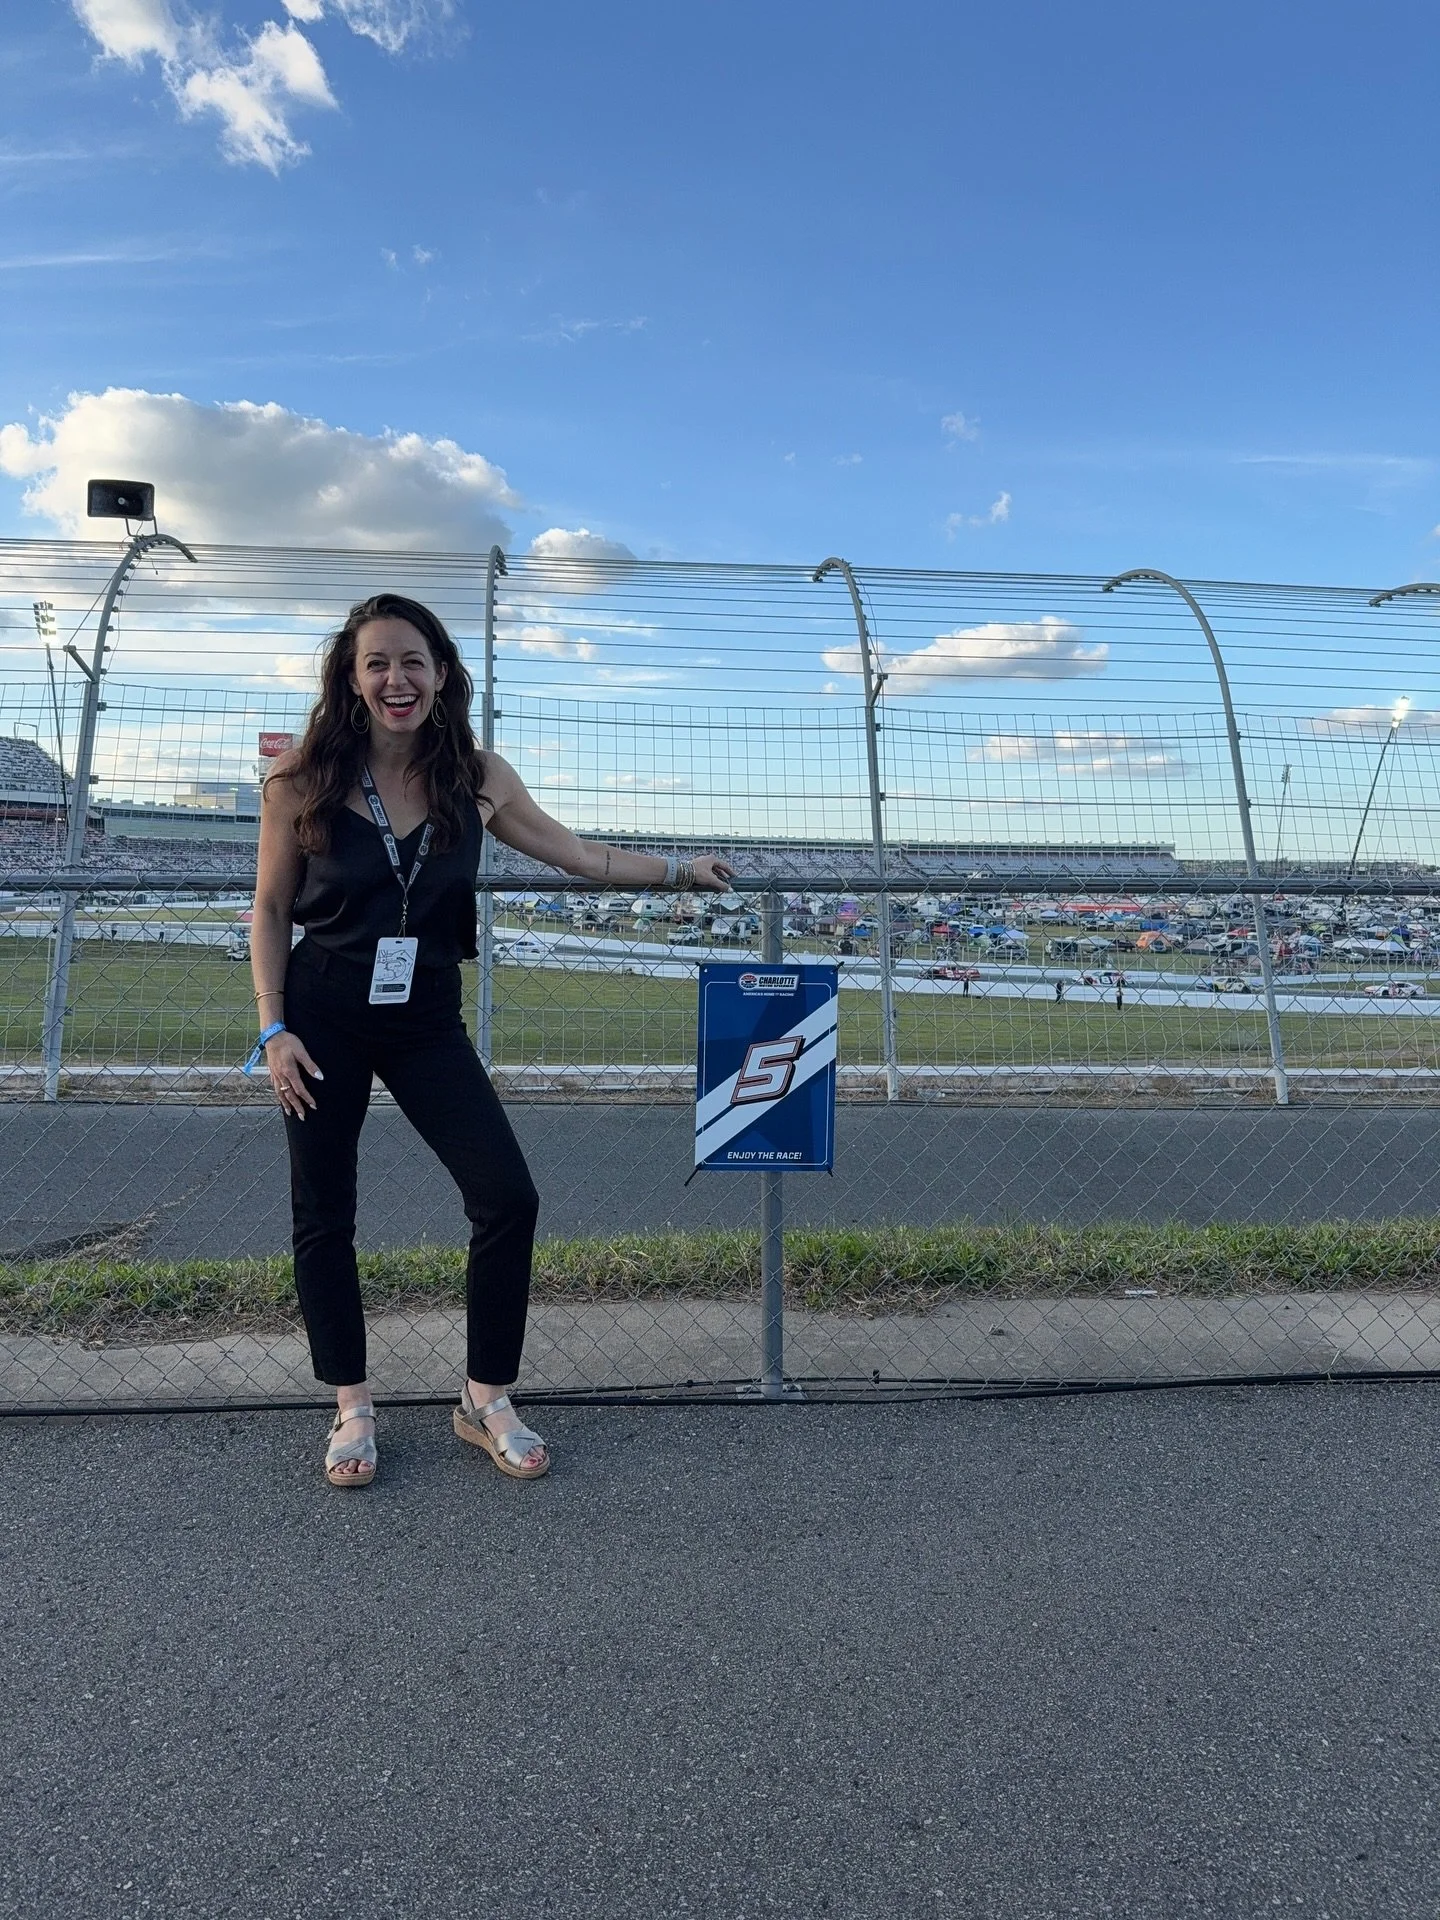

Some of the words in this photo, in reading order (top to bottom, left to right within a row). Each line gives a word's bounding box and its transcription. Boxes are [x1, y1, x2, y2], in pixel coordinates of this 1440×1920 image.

[730, 1035, 805, 1106] 5
[727, 1151, 756, 1159] ENJOY
[776, 1152, 802, 1160] RACE!
